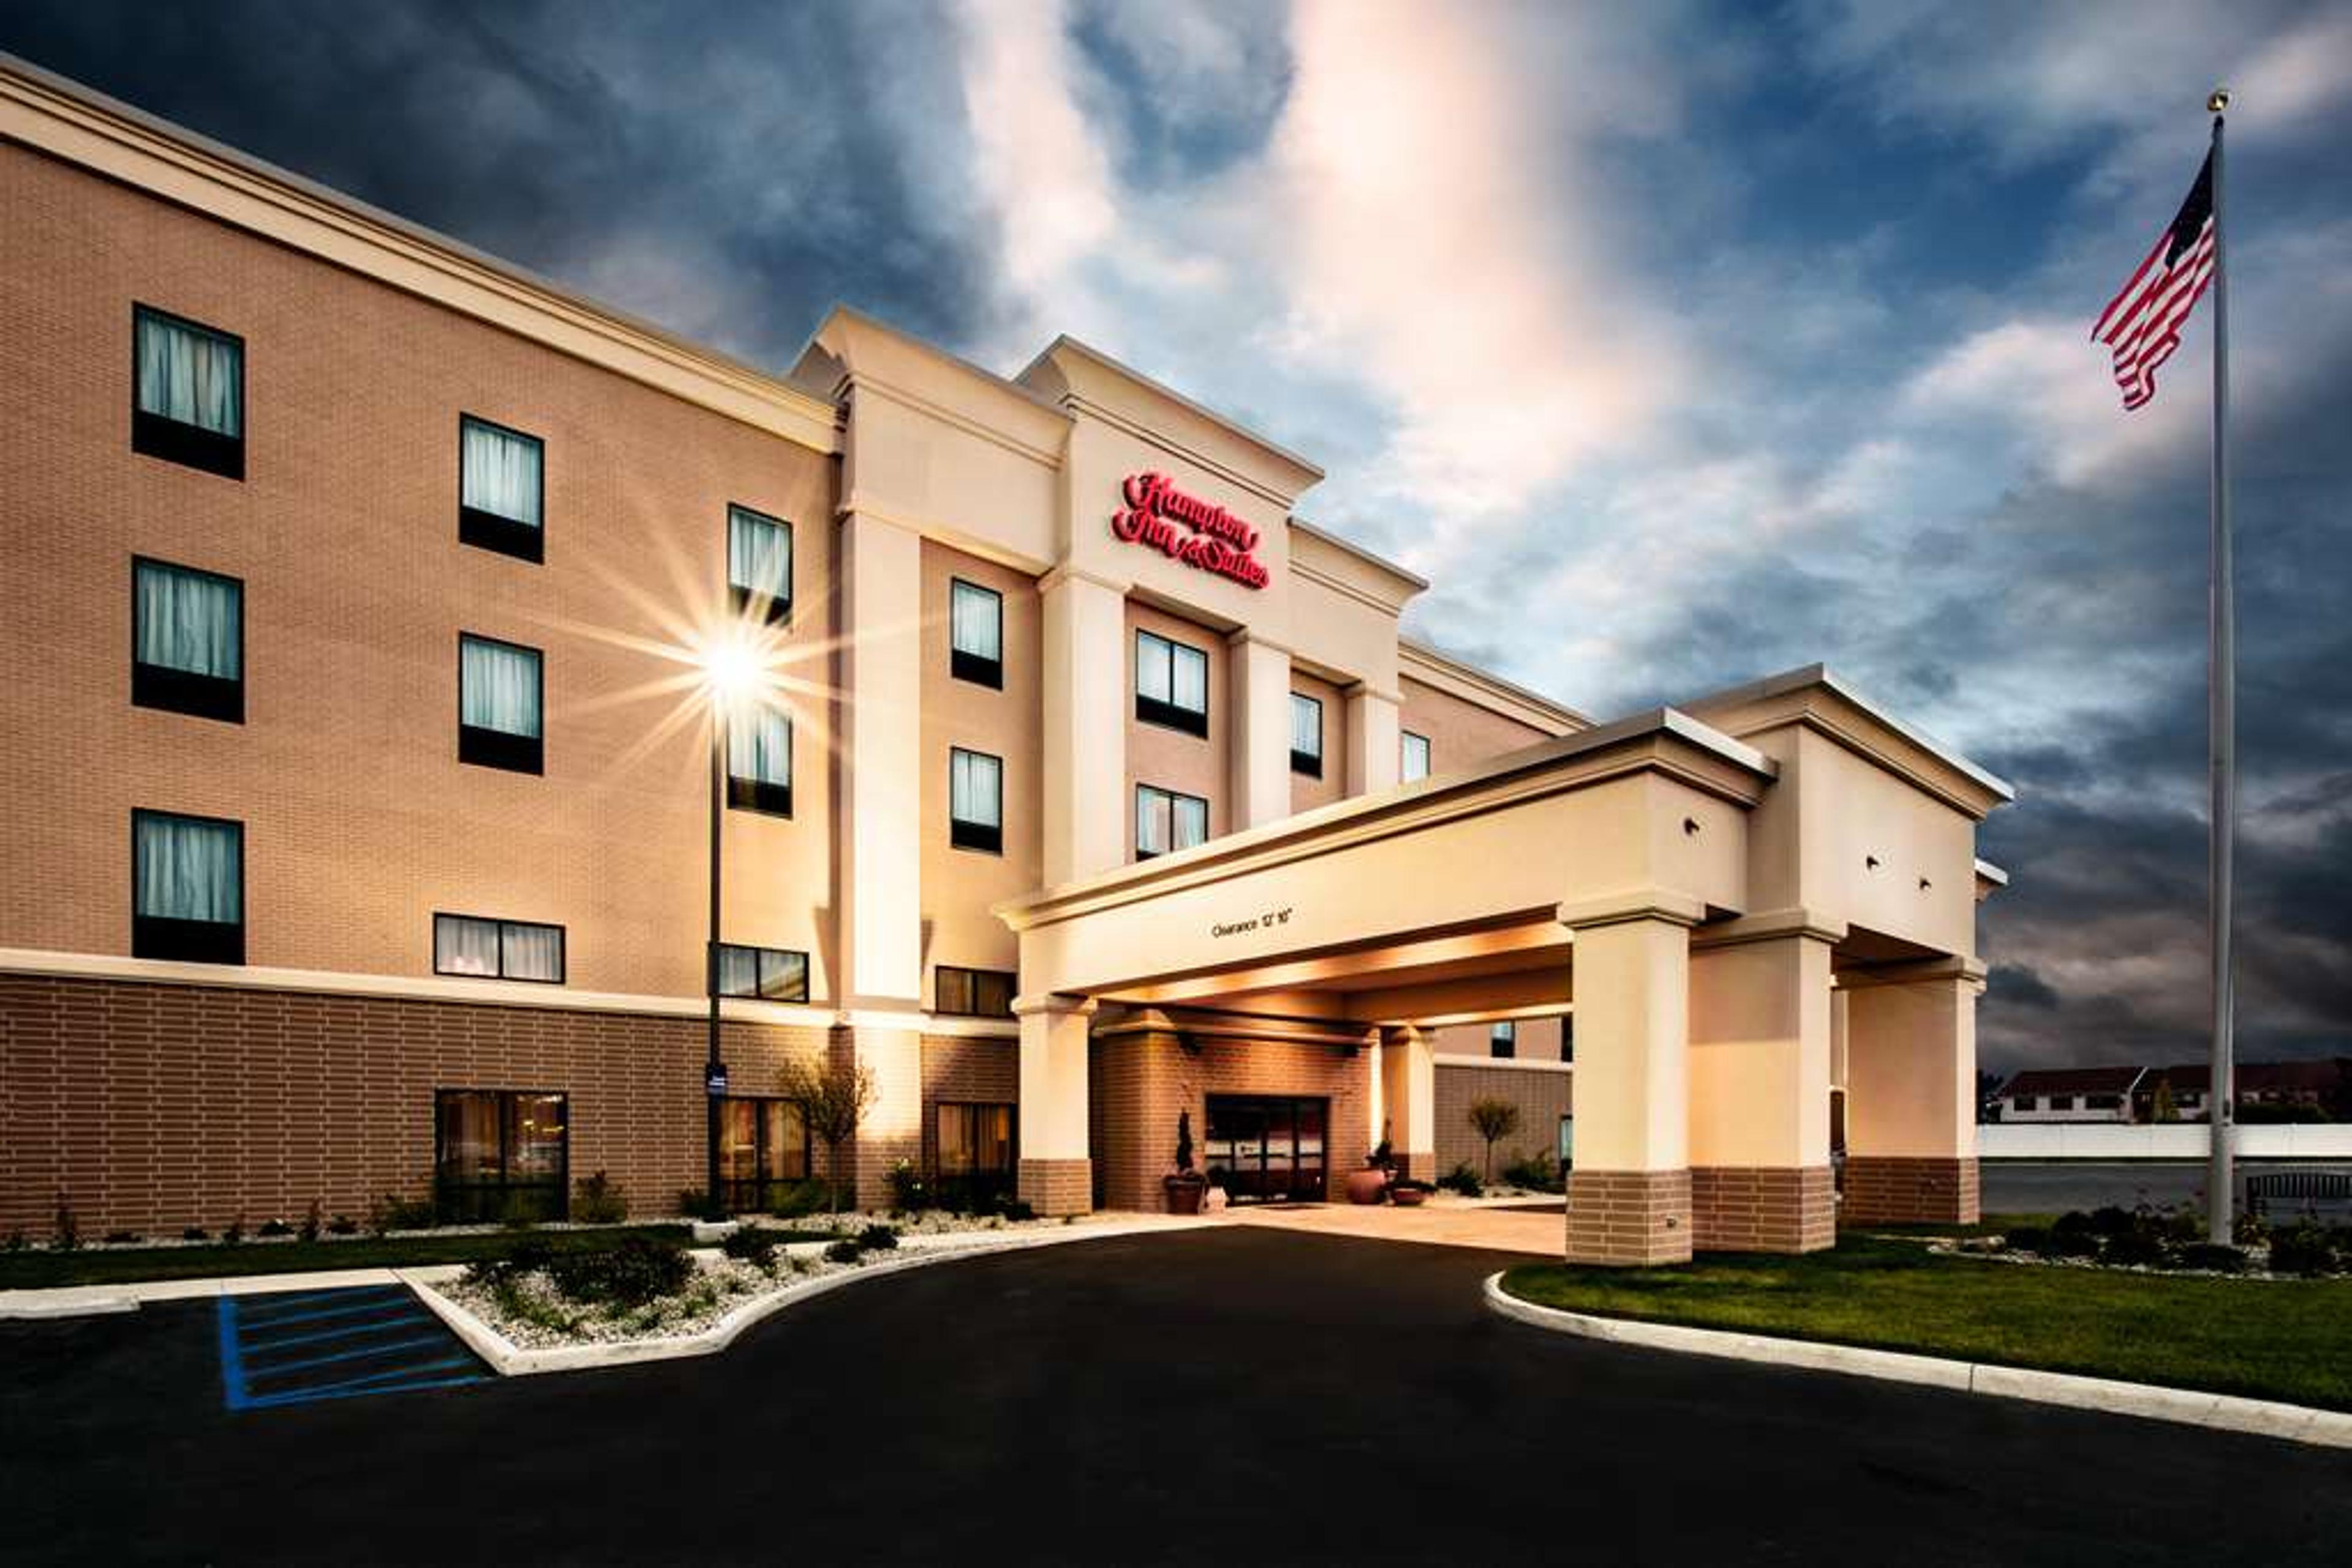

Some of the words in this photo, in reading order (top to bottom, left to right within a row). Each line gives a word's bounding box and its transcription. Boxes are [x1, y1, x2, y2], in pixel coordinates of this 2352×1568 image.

[1111, 510, 1177, 558] Inn
[1197, 539, 1270, 589] Suites
[1123, 473, 1259, 552] Hampton
[1212, 920, 1257, 938] Clearance
